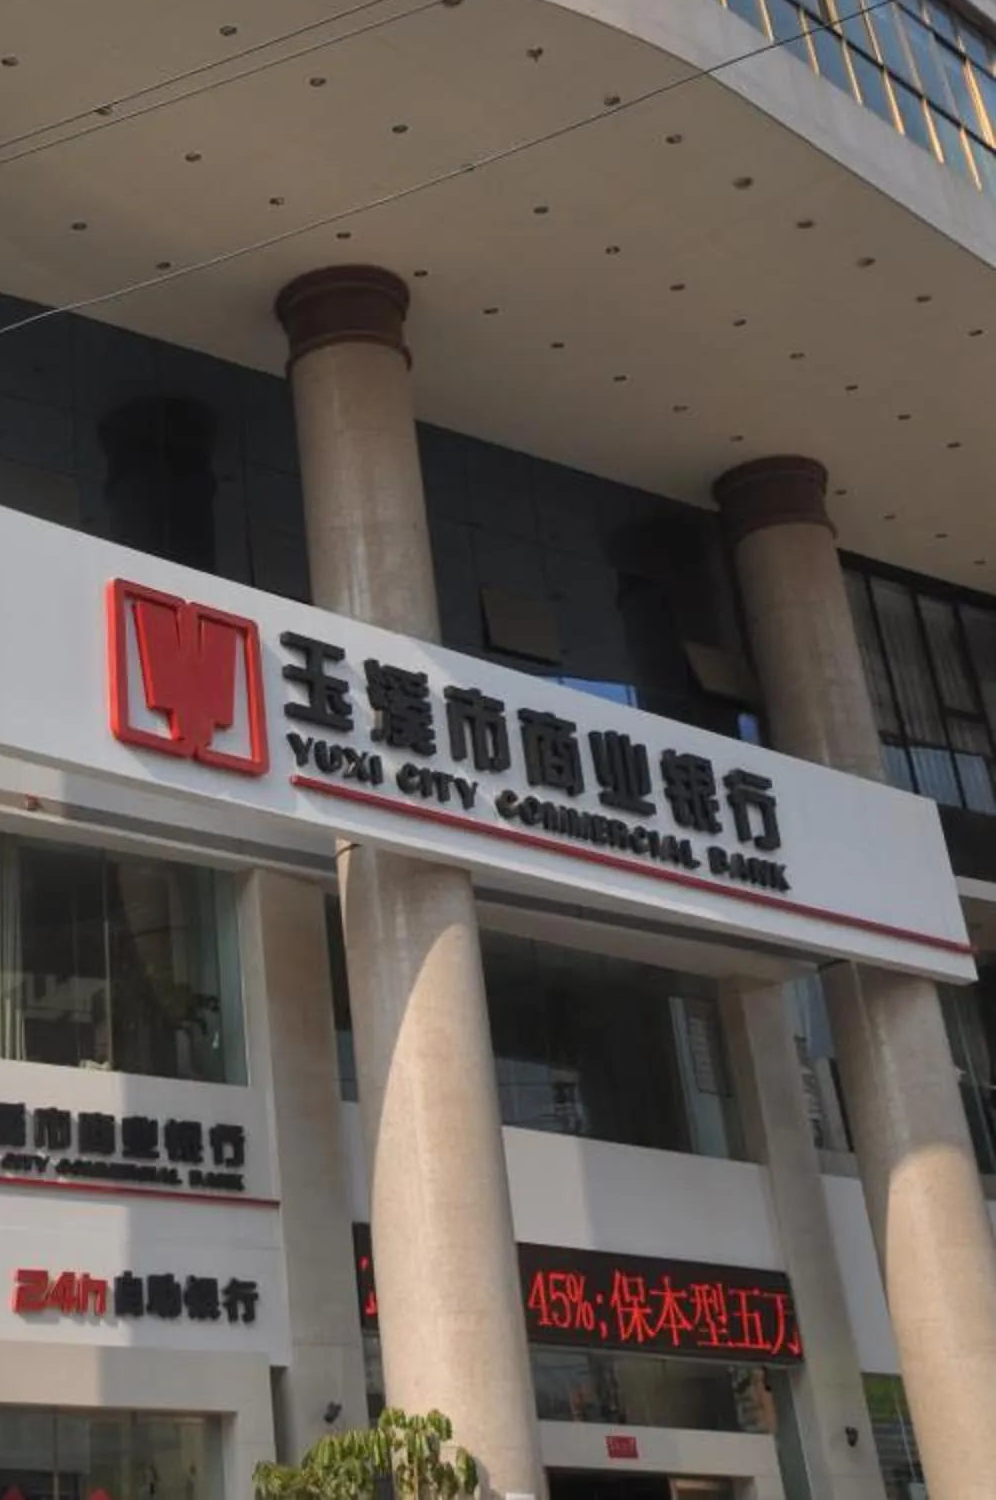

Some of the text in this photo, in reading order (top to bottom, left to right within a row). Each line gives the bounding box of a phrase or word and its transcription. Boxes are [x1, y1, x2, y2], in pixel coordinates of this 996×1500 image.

[279, 630, 781, 850] 玉溪市商业银行
[286, 732, 792, 893] YUXI CITY COMMERCIAL BANK
